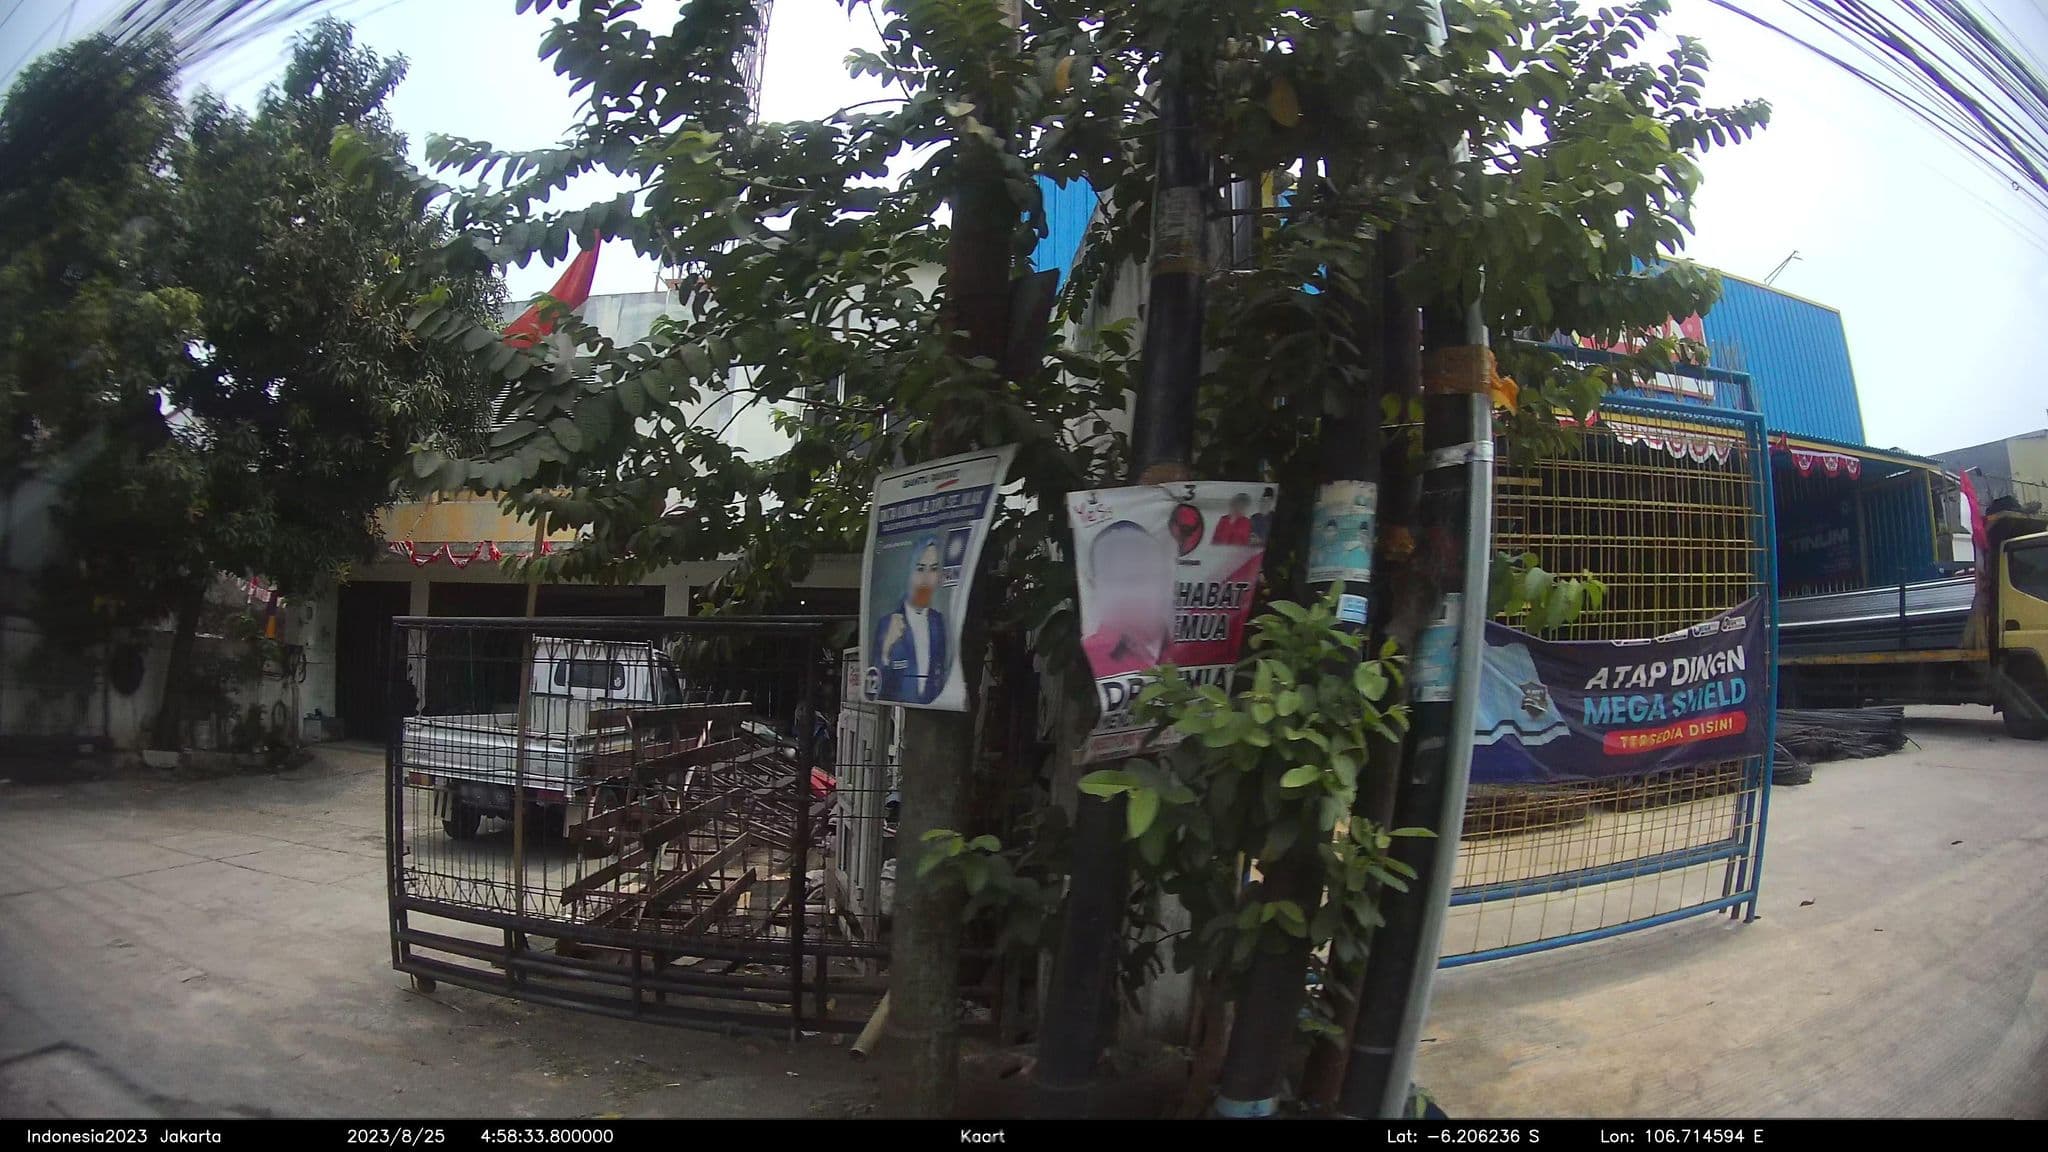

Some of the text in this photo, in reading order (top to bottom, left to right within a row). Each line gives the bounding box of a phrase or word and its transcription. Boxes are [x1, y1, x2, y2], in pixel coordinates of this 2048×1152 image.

[1184, 484, 1196, 501] 3
[1585, 660, 1668, 690] ATAP
[1583, 692, 1666, 725] MEGA
[1619, 717, 1733, 749] TERSEDIA DISINI
